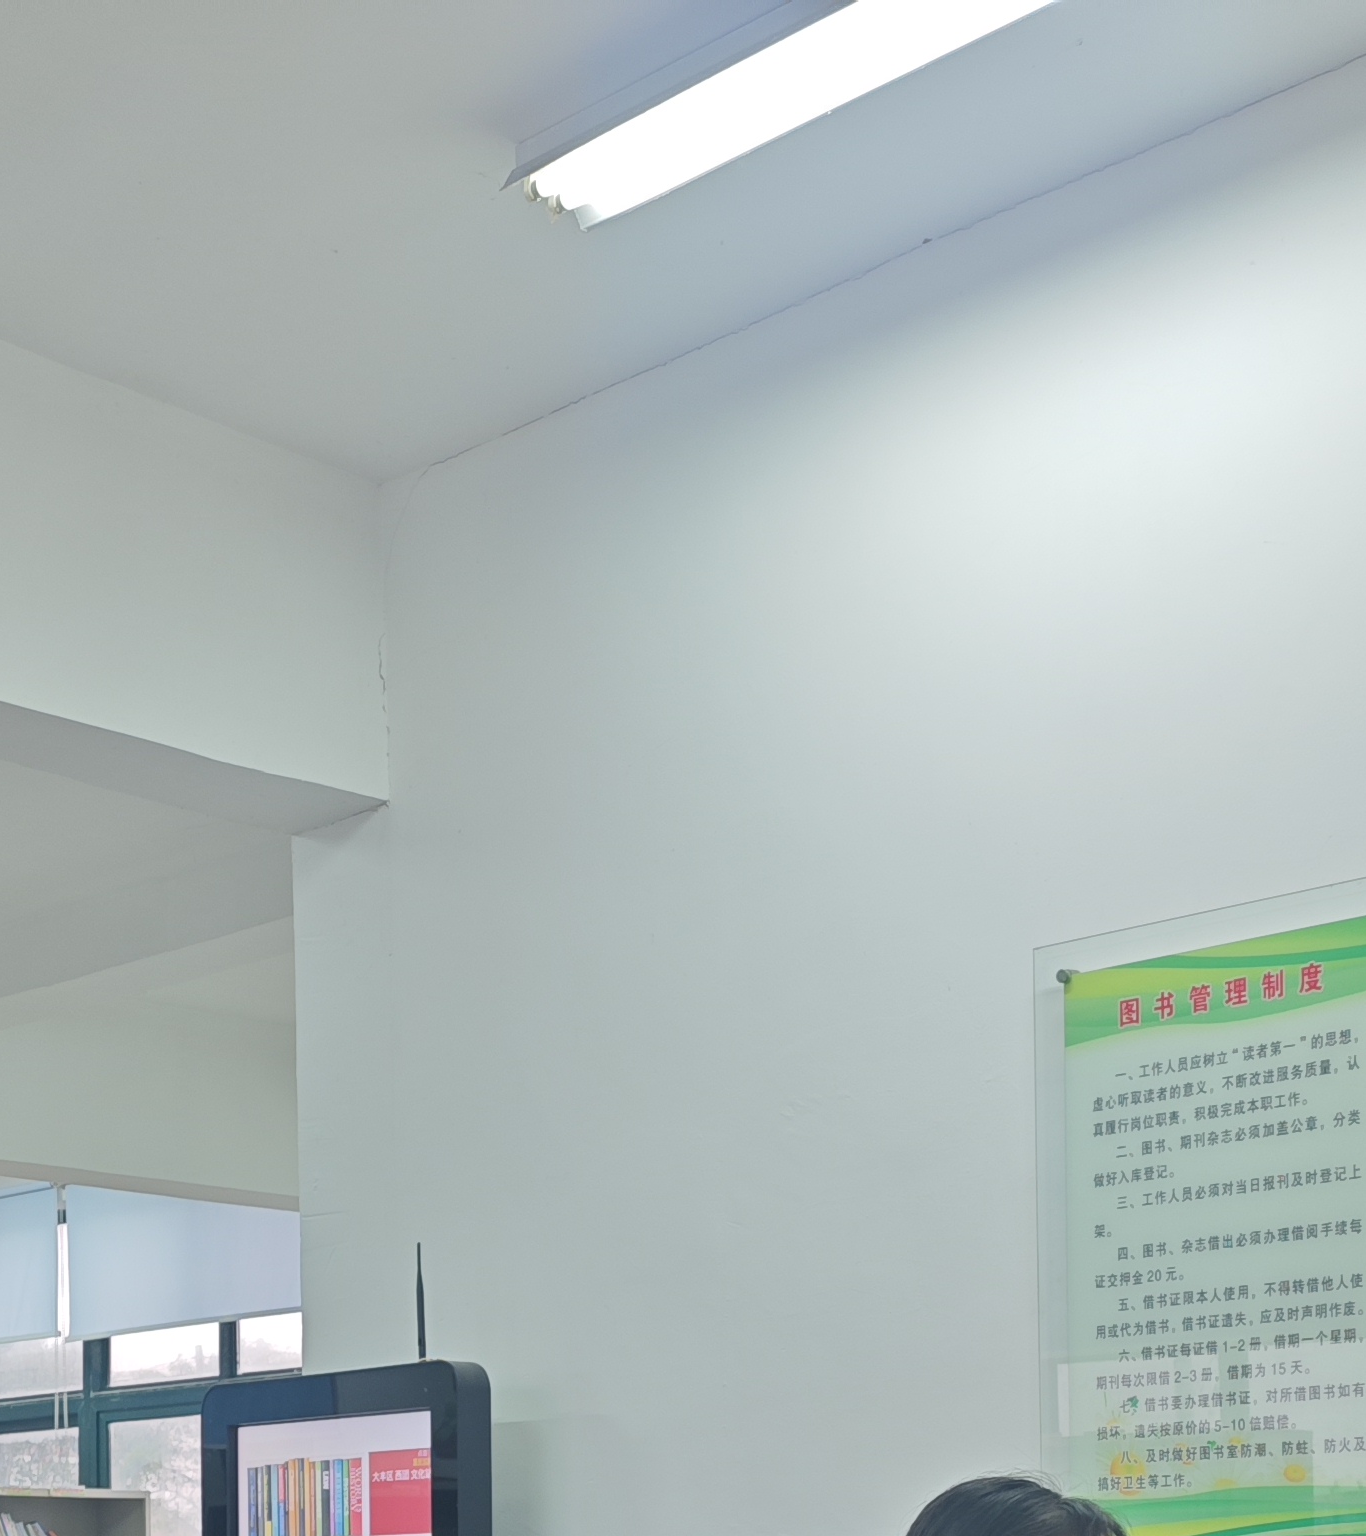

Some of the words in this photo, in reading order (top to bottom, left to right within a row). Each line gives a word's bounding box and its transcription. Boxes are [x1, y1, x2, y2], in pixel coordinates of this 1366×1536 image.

[1118, 962, 1325, 1028] 图书管理制度
[1115, 1109, 1361, 1159] 二、图书、期刊杂志必须加盖公章，分类
[1093, 1164, 1175, 1189] 做好入库登记。
[1116, 1163, 1362, 1210] 三、工作人员必须对当日报刊及时登记上
[1094, 1224, 1113, 1239] 架。
[1117, 1218, 1363, 1261] 四、图书、杂志借出必须办理借阅手续每
[1097, 1472, 1192, 1492] 搞好卫生等工作。
